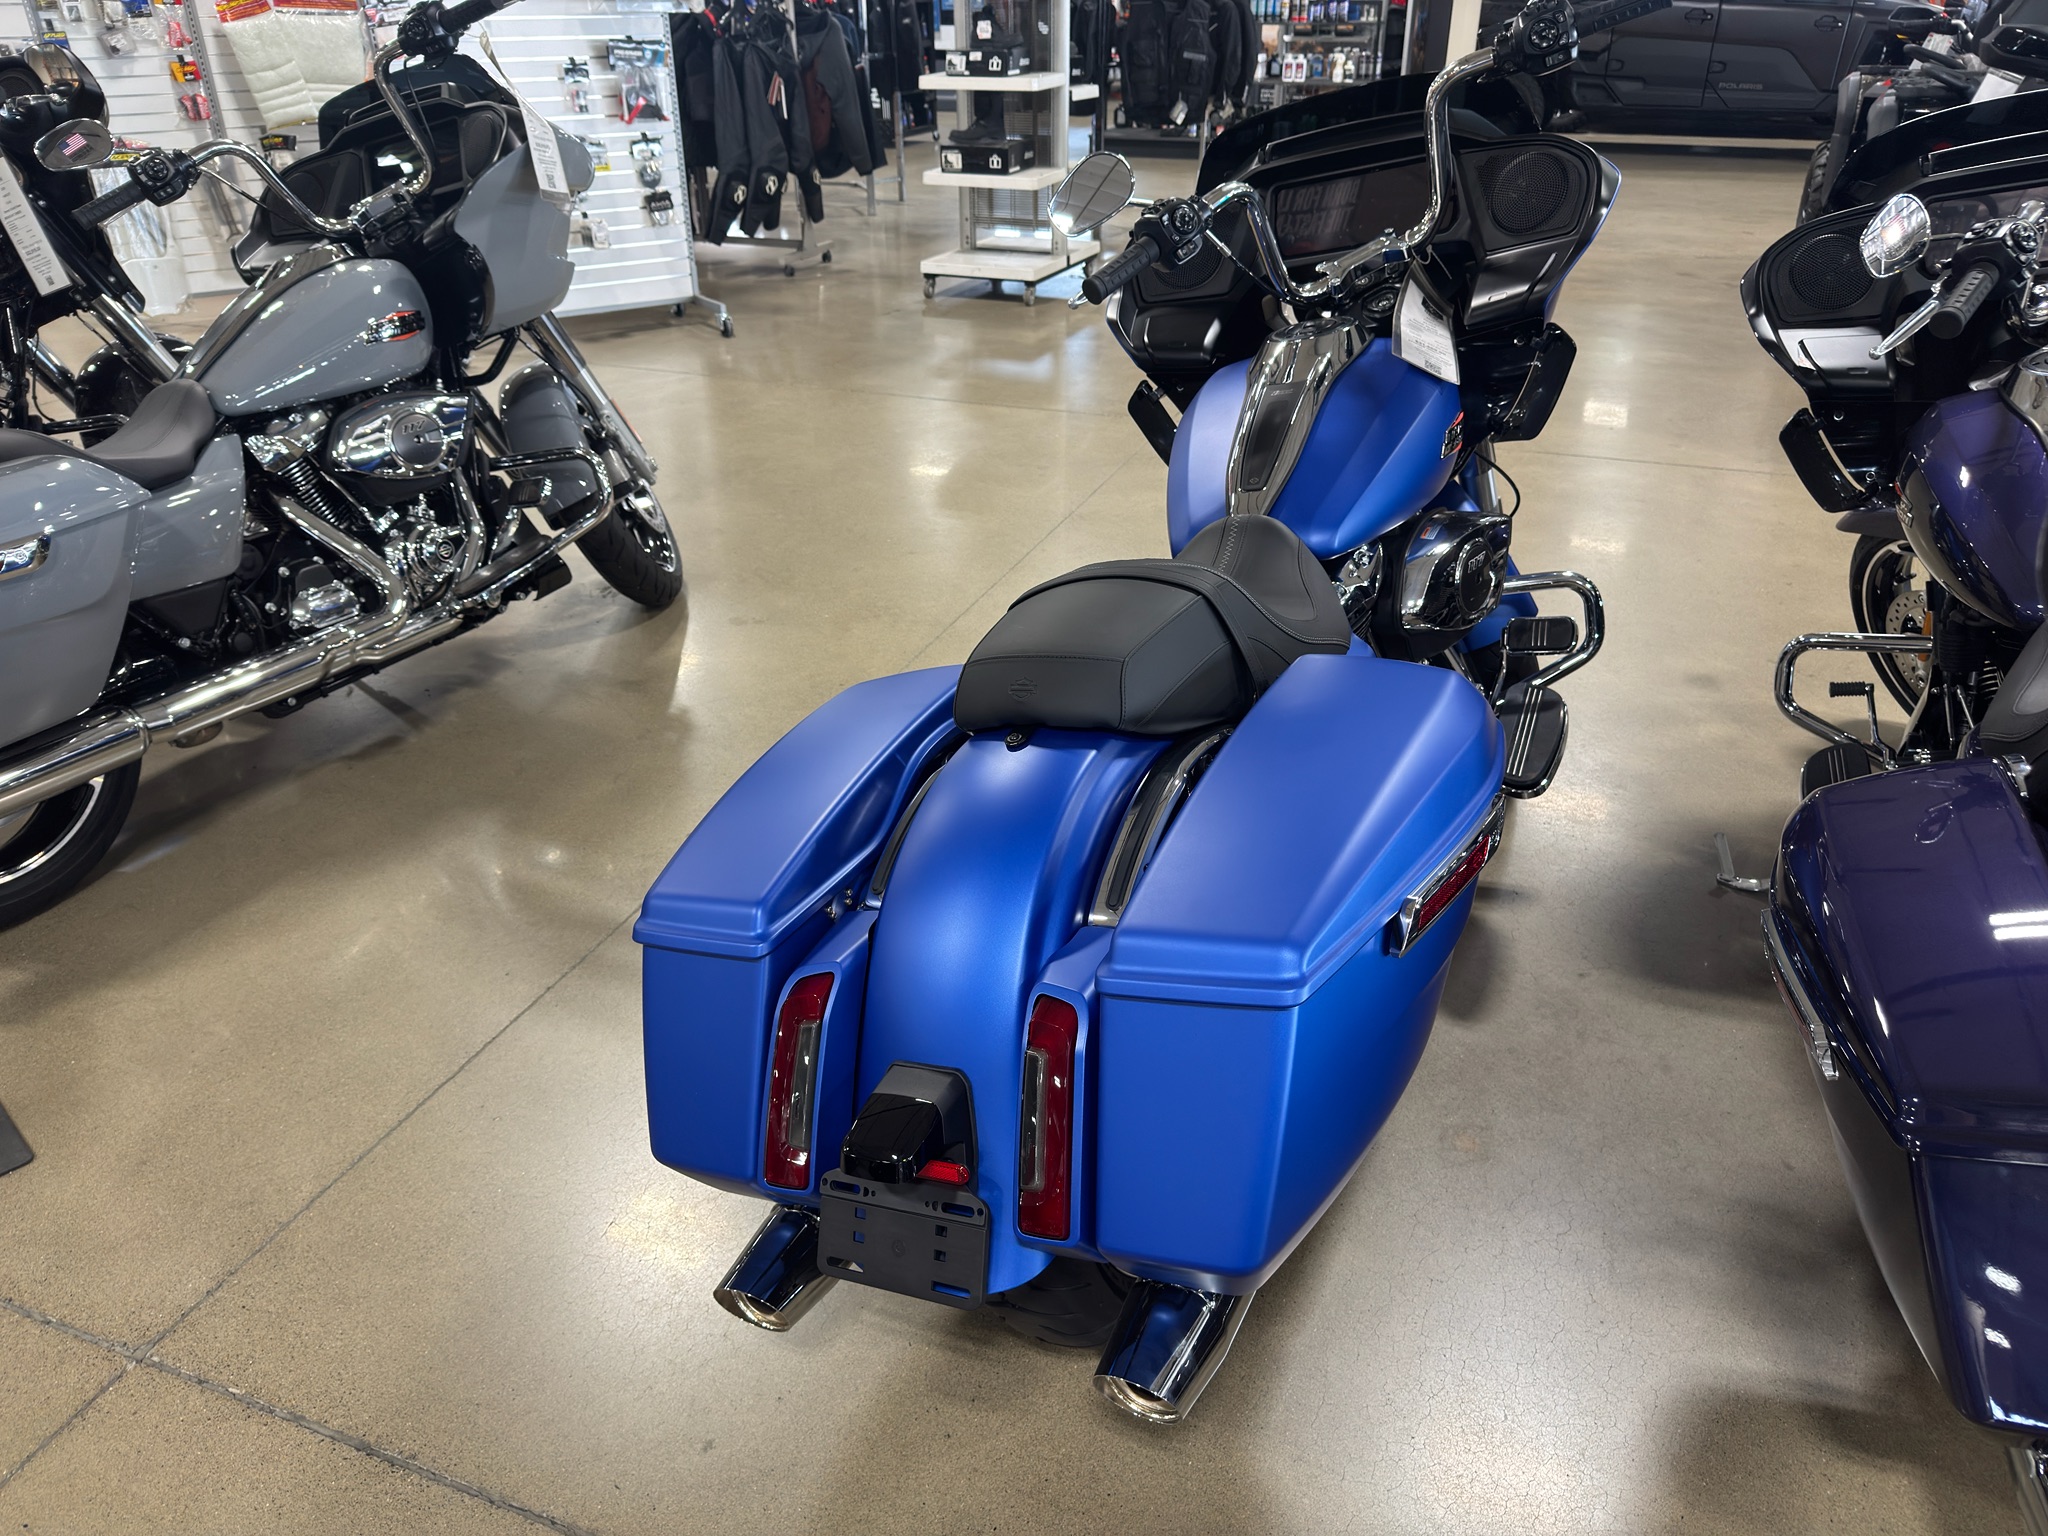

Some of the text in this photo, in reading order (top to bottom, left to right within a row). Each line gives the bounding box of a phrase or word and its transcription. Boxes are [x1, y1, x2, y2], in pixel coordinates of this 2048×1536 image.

[1719, 82, 1763, 90] POLARIS
[402, 420, 426, 435] 117
[1468, 551, 1486, 573] 117
